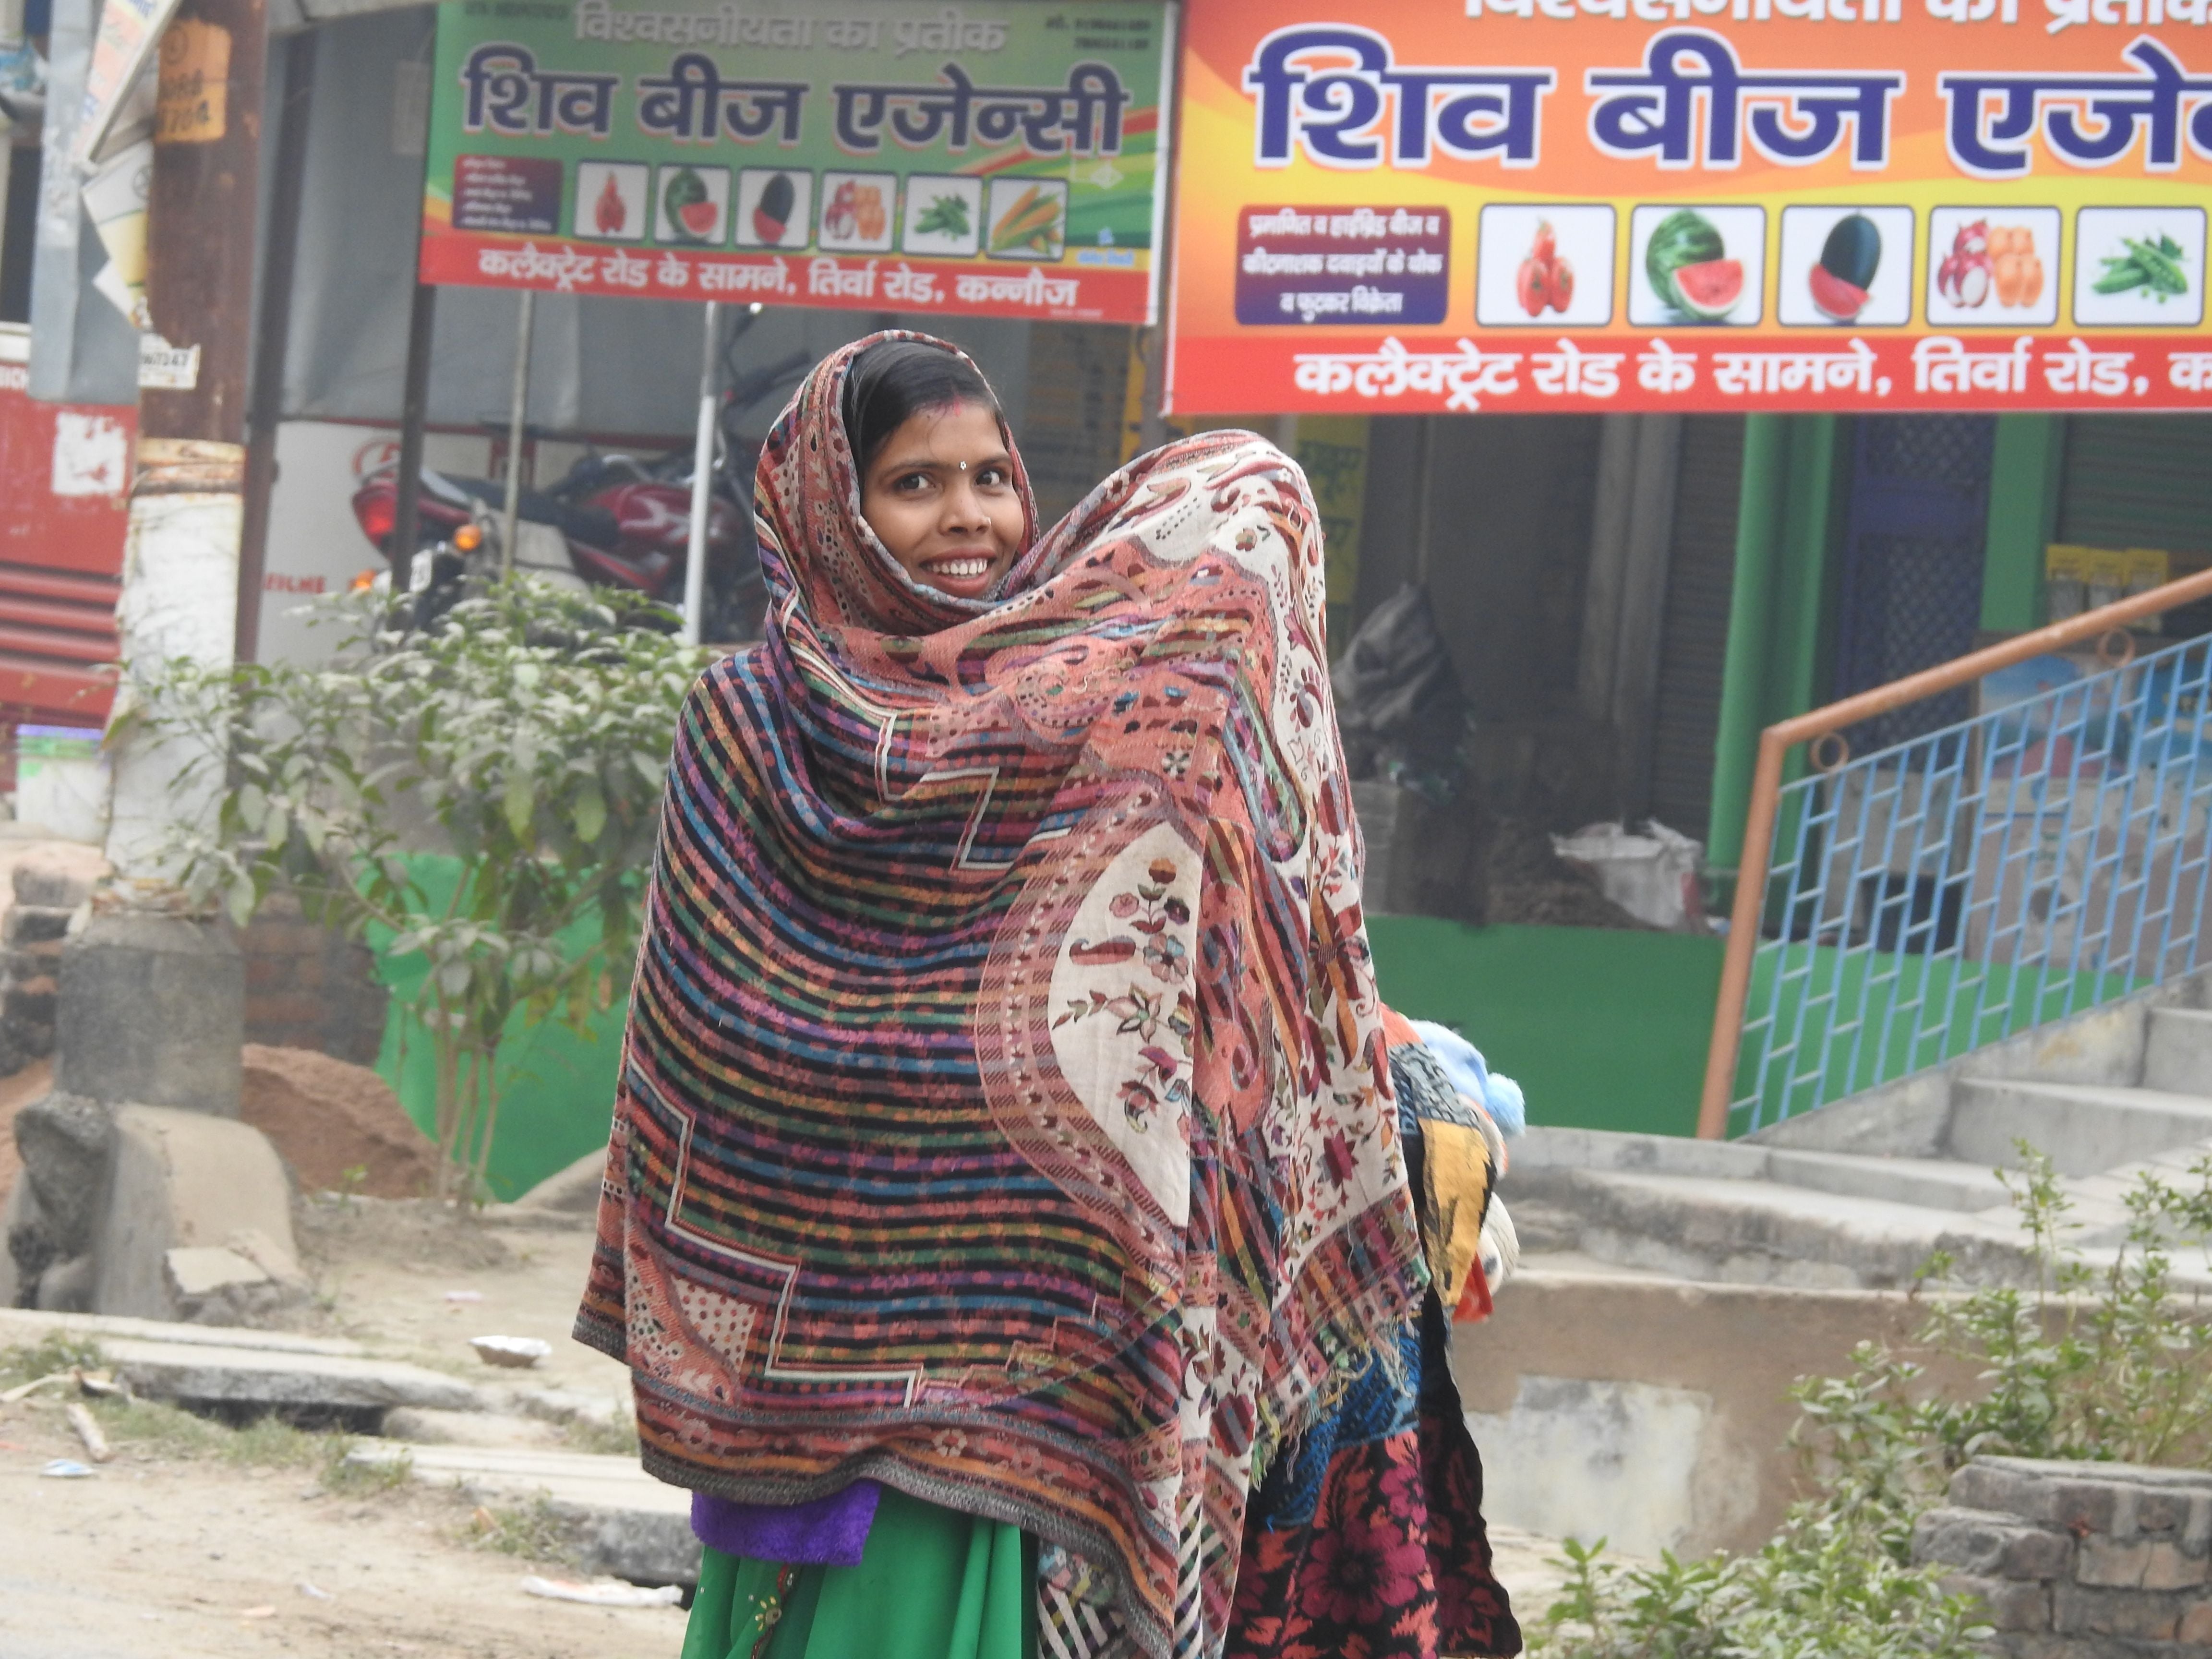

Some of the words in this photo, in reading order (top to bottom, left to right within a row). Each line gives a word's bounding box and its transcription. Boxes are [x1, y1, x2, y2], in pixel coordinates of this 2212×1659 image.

[822, 17, 884, 51] का
[889, 8, 1010, 60] प्रतीक
[460, 41, 623, 136] शिव
[637, 50, 813, 146] बीज
[830, 60, 1134, 156] एजेन्सी
[1242, 22, 1558, 170] शिव
[1584, 26, 1908, 172] बीज
[1936, 34, 2212, 180] एजे
[601, 248, 652, 288] रोड
[657, 252, 691, 287] के
[808, 256, 878, 298] तिर्वा
[883, 262, 946, 303] रोड,
[955, 266, 1081, 307] कन्नौज
[1293, 336, 1524, 412] कलैक्ट्रेट
[1531, 337, 1626, 397] रोड
[1636, 338, 1698, 393] के
[1712, 337, 1892, 397] सामने,
[1911, 336, 2033, 393] तिर्वा
[2043, 337, 2149, 397] रोड,
